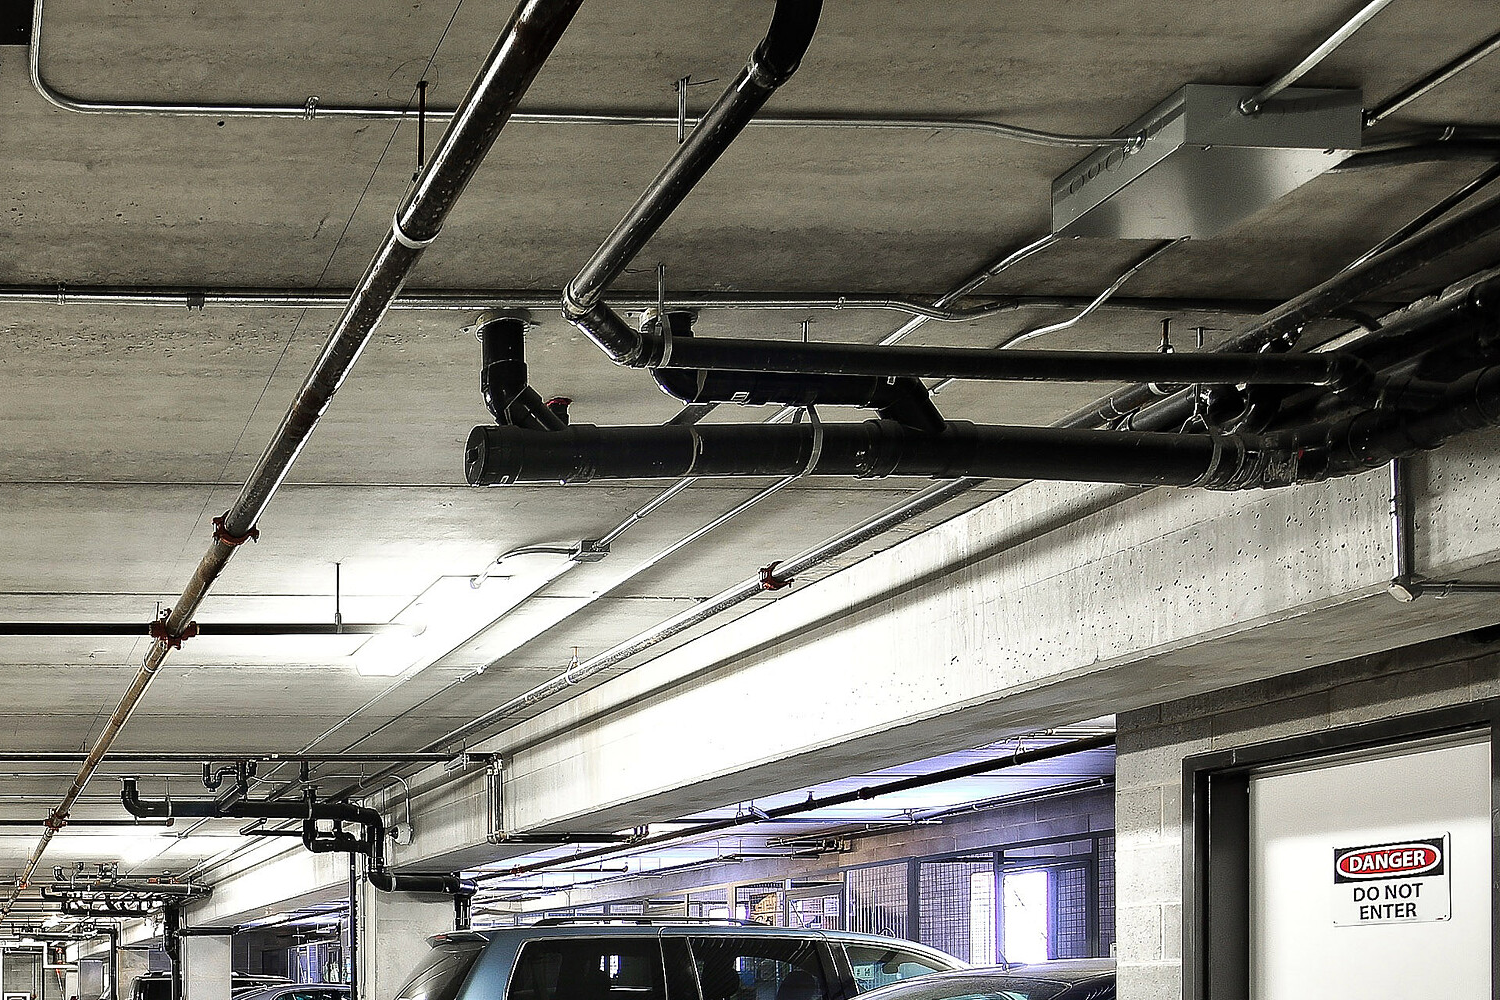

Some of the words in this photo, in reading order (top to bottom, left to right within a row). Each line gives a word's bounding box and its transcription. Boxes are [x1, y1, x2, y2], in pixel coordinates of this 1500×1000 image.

[1349, 850, 1426, 873] DANGER
[1353, 886, 1380, 902] DO
[1385, 882, 1424, 900] NOT
[1359, 902, 1417, 920] ENTER
